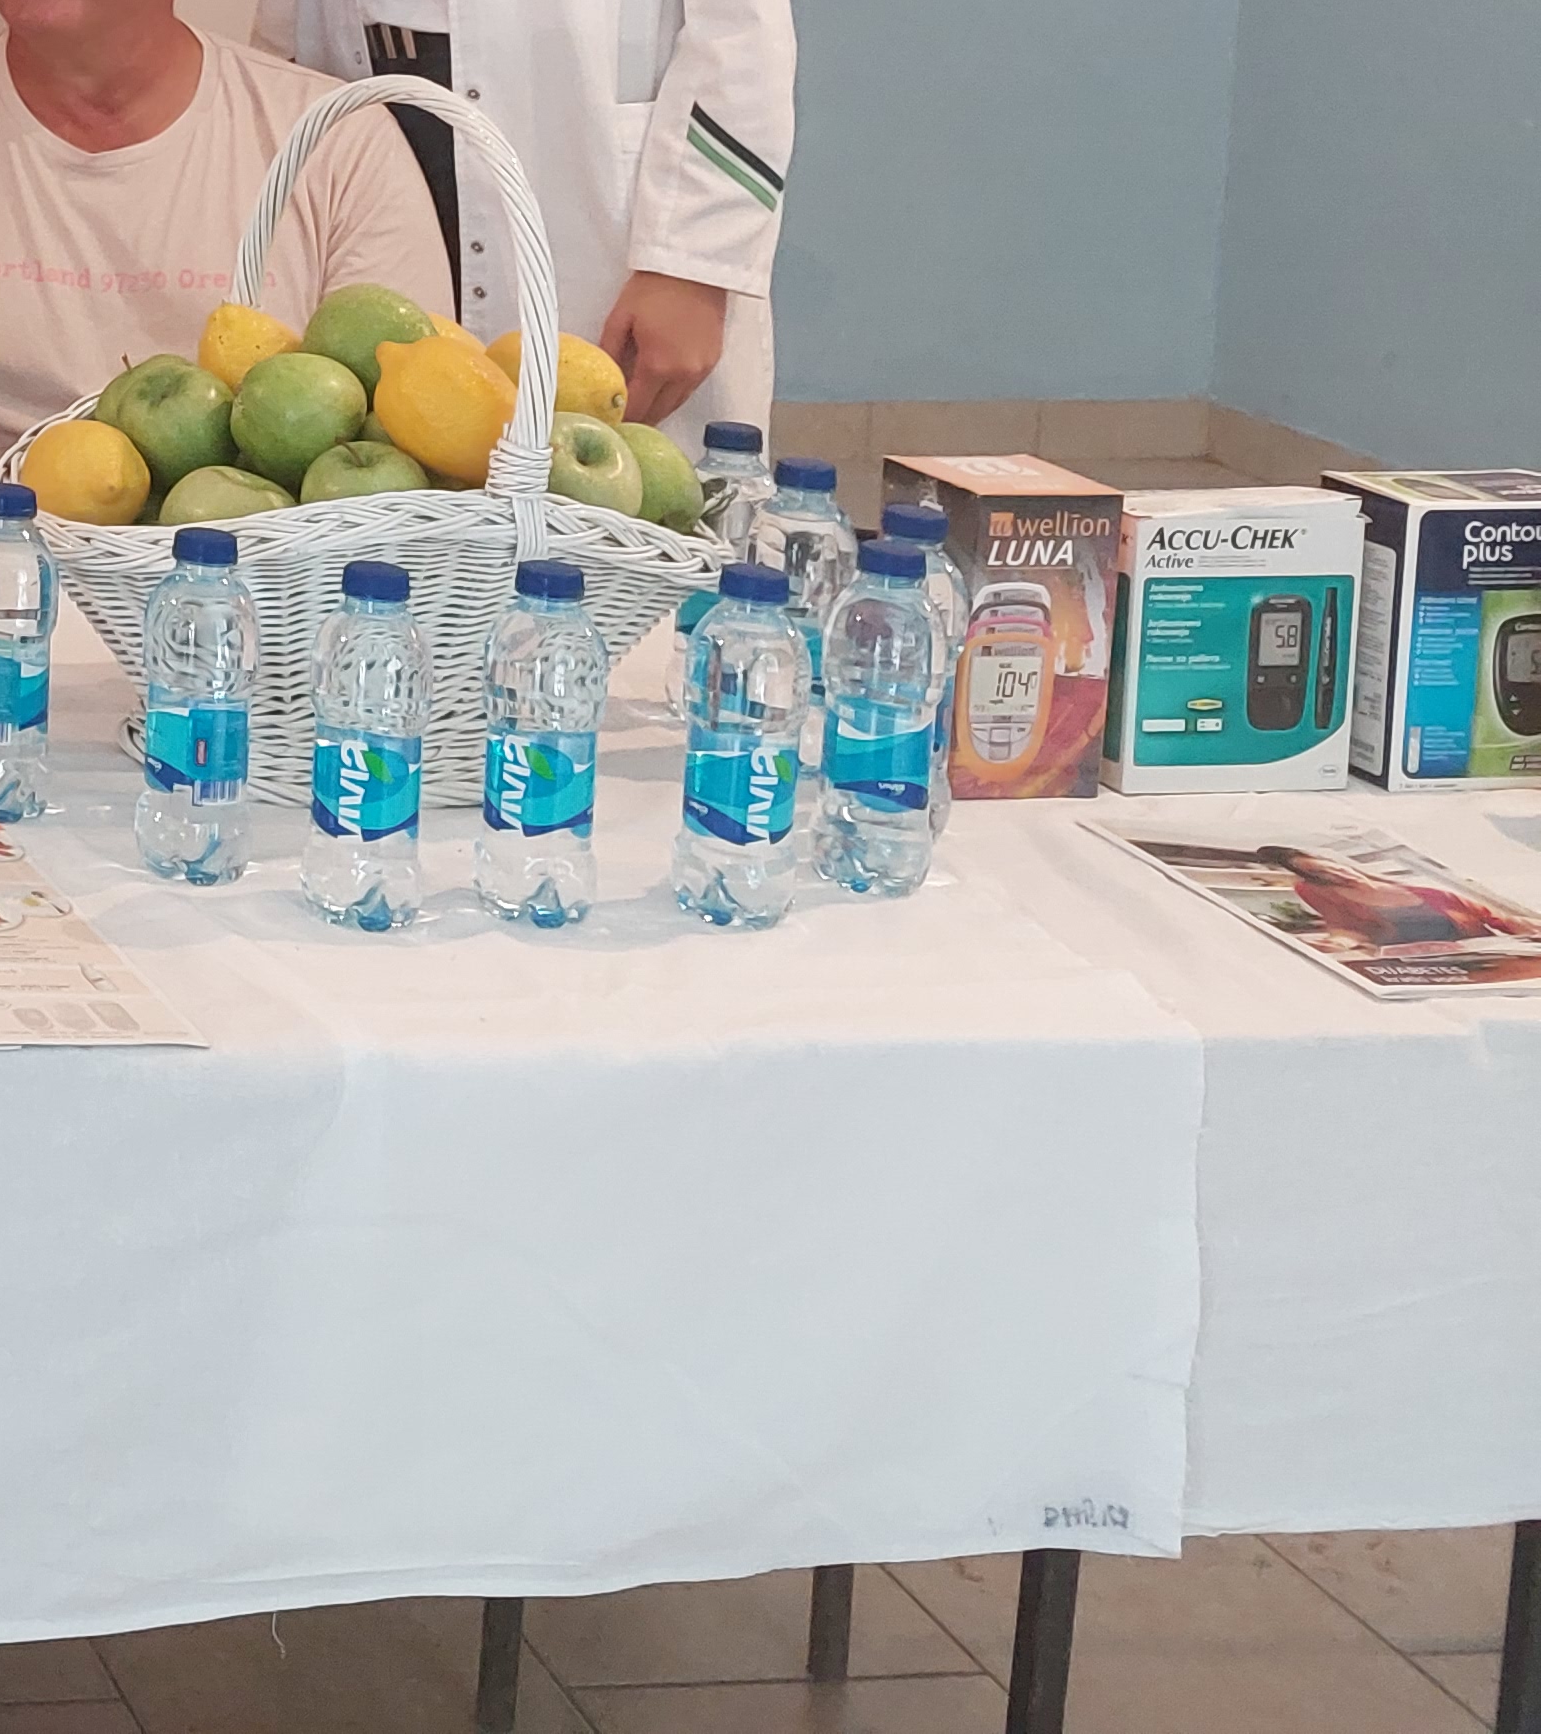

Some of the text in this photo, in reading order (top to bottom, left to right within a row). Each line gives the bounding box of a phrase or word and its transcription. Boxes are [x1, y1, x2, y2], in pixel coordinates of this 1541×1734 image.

[178, 268, 277, 290] Oren
[1146, 524, 1299, 552] ACCU-CHEK
[987, 539, 1074, 566] LUNA
[1144, 553, 1195, 569] Active
[1462, 542, 1514, 570] plus
